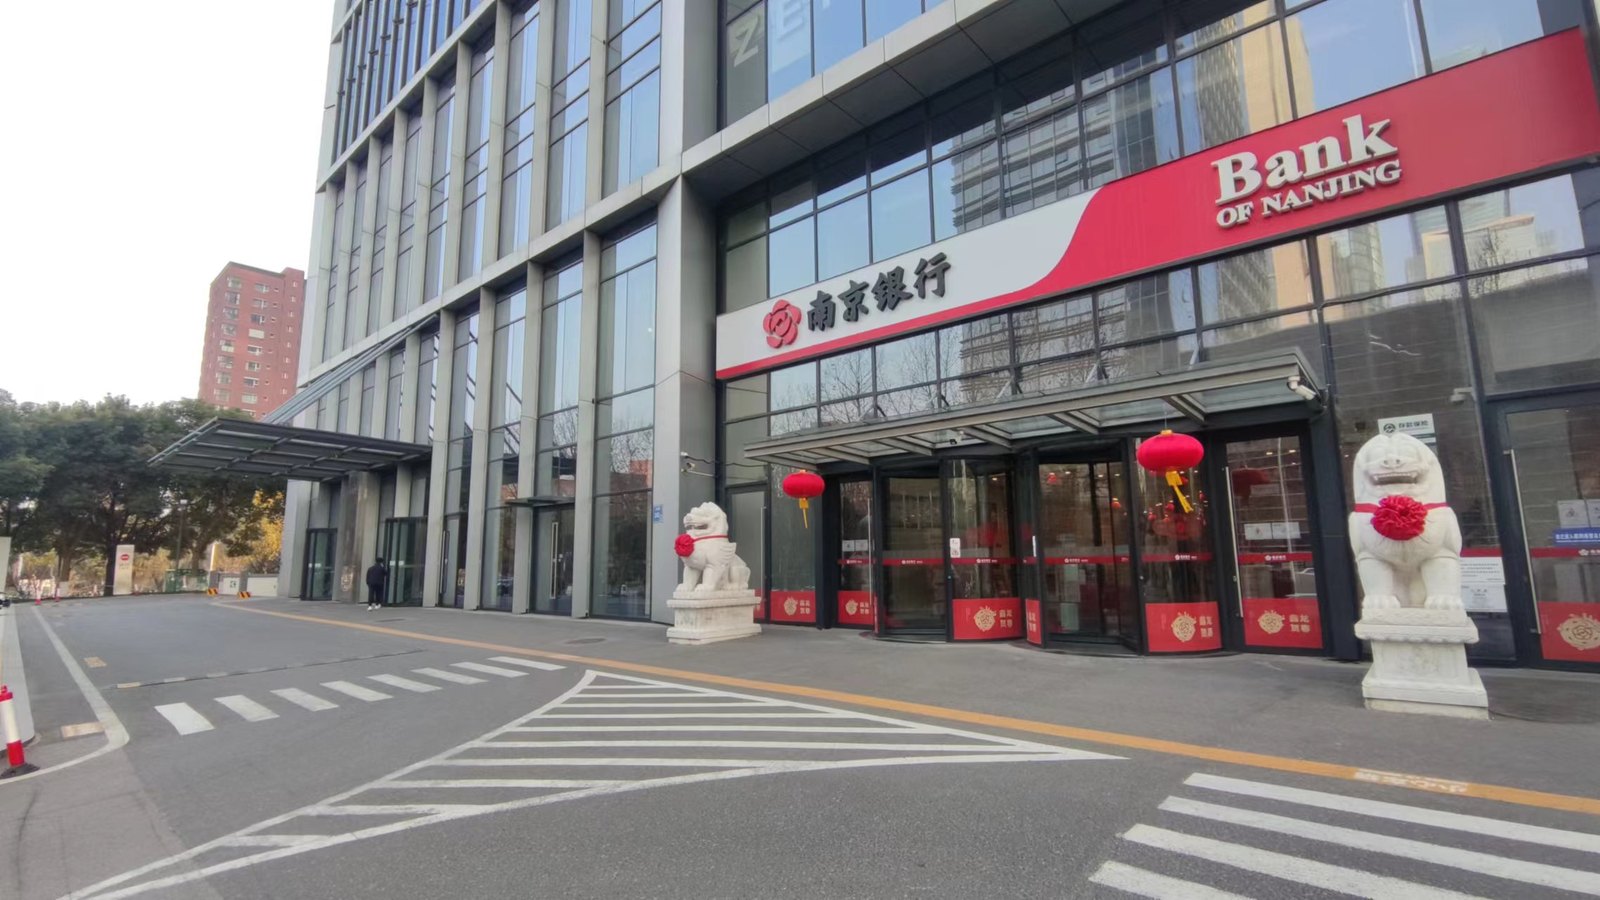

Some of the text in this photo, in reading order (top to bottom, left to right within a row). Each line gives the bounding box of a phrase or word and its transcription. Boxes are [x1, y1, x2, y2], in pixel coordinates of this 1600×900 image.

[1211, 114, 1398, 206] Bank
[1216, 159, 1402, 228] OF NANJING
